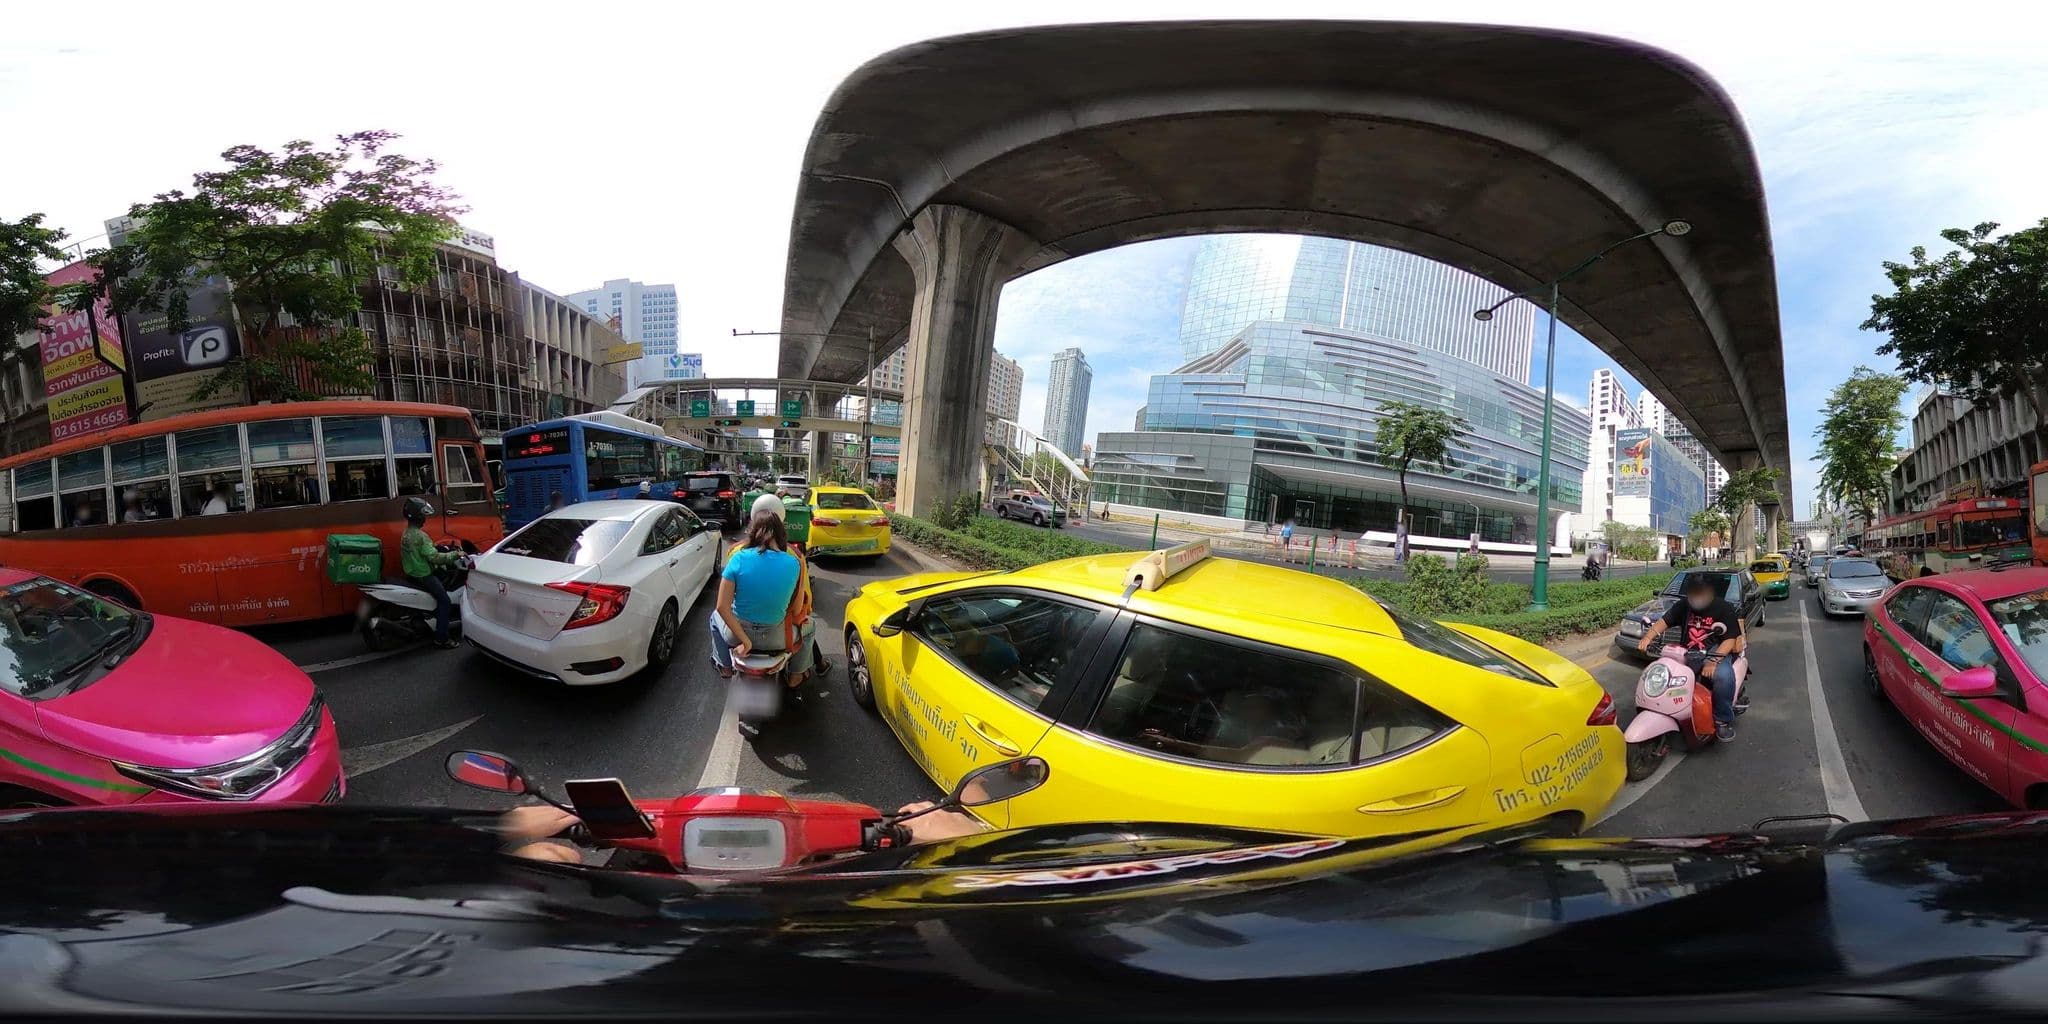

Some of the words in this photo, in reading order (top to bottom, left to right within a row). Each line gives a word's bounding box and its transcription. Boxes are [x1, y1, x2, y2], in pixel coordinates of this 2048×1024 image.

[54, 425, 67, 438] 02
[69, 418, 91, 433] 615
[93, 409, 125, 428] 4665
[347, 563, 371, 573] Grab
[1532, 731, 1600, 786] 02-2156906
[1493, 788, 1534, 813] โทร.
